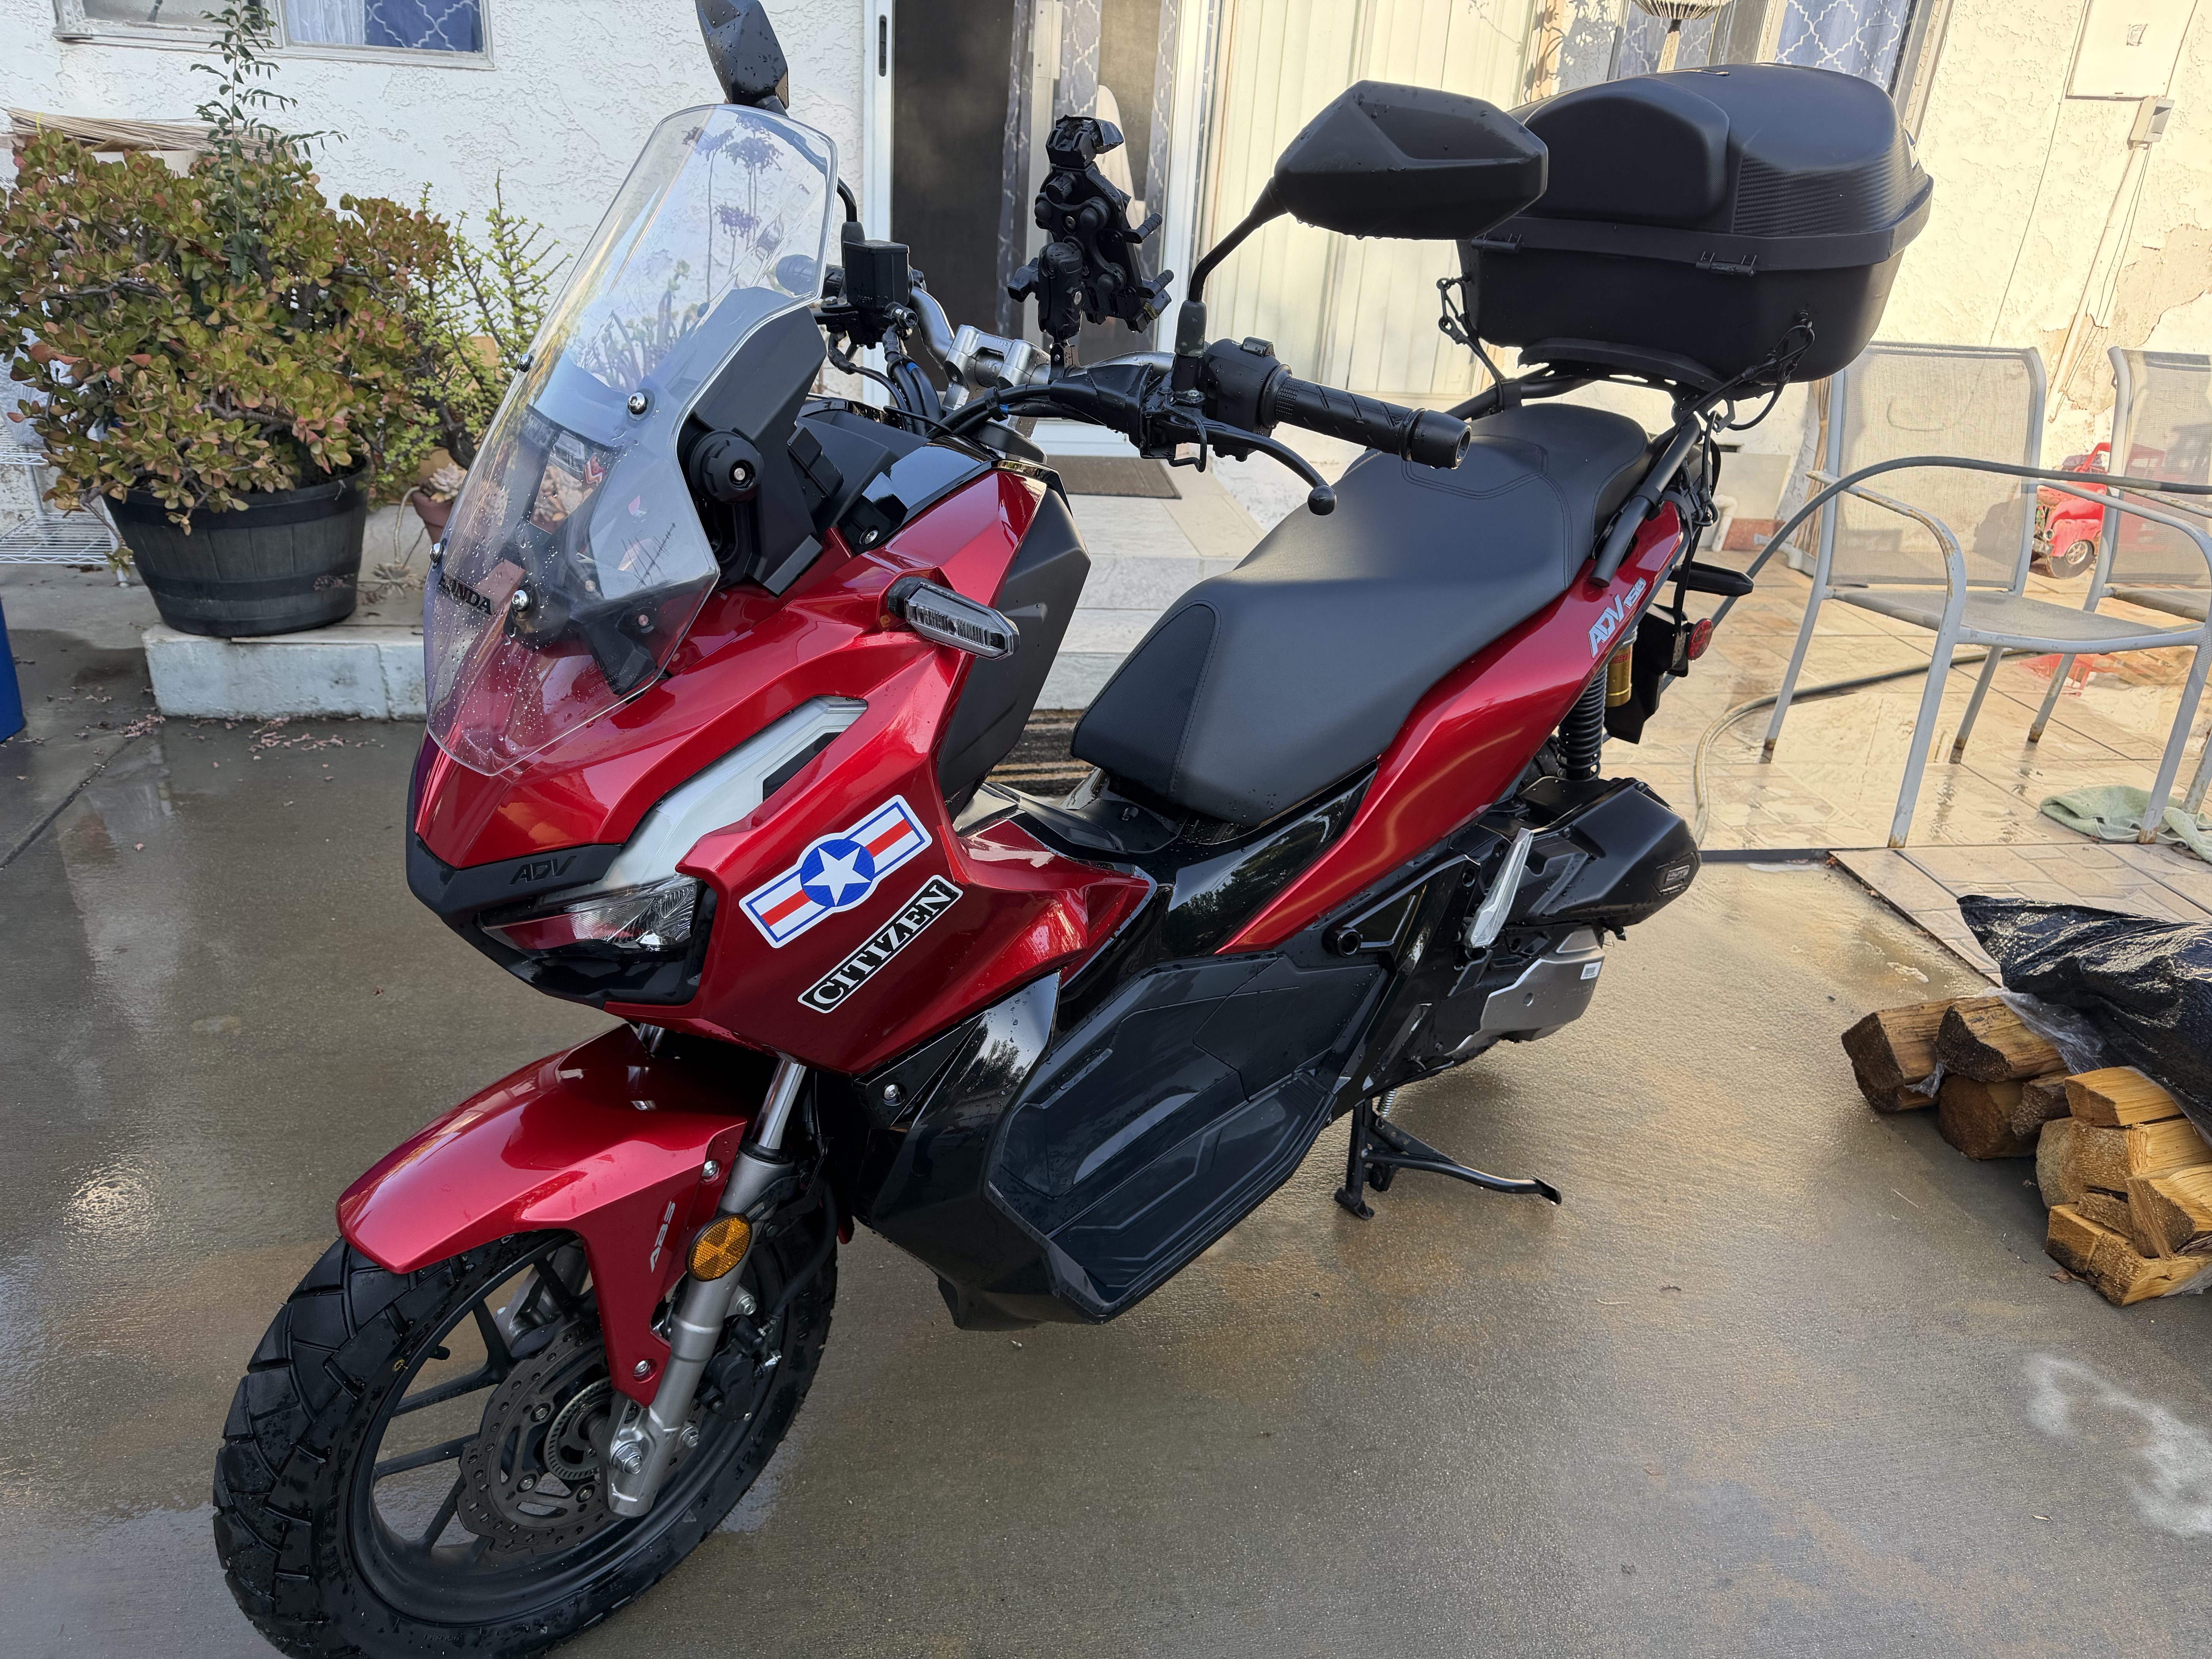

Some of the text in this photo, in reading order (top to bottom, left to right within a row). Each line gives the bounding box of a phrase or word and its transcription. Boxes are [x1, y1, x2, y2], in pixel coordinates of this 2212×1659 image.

[1588, 577, 1646, 658] ADV 150
[510, 856, 577, 885] ADV
[814, 885, 952, 1004] CITIZEN
[650, 1200, 675, 1273] ABS
